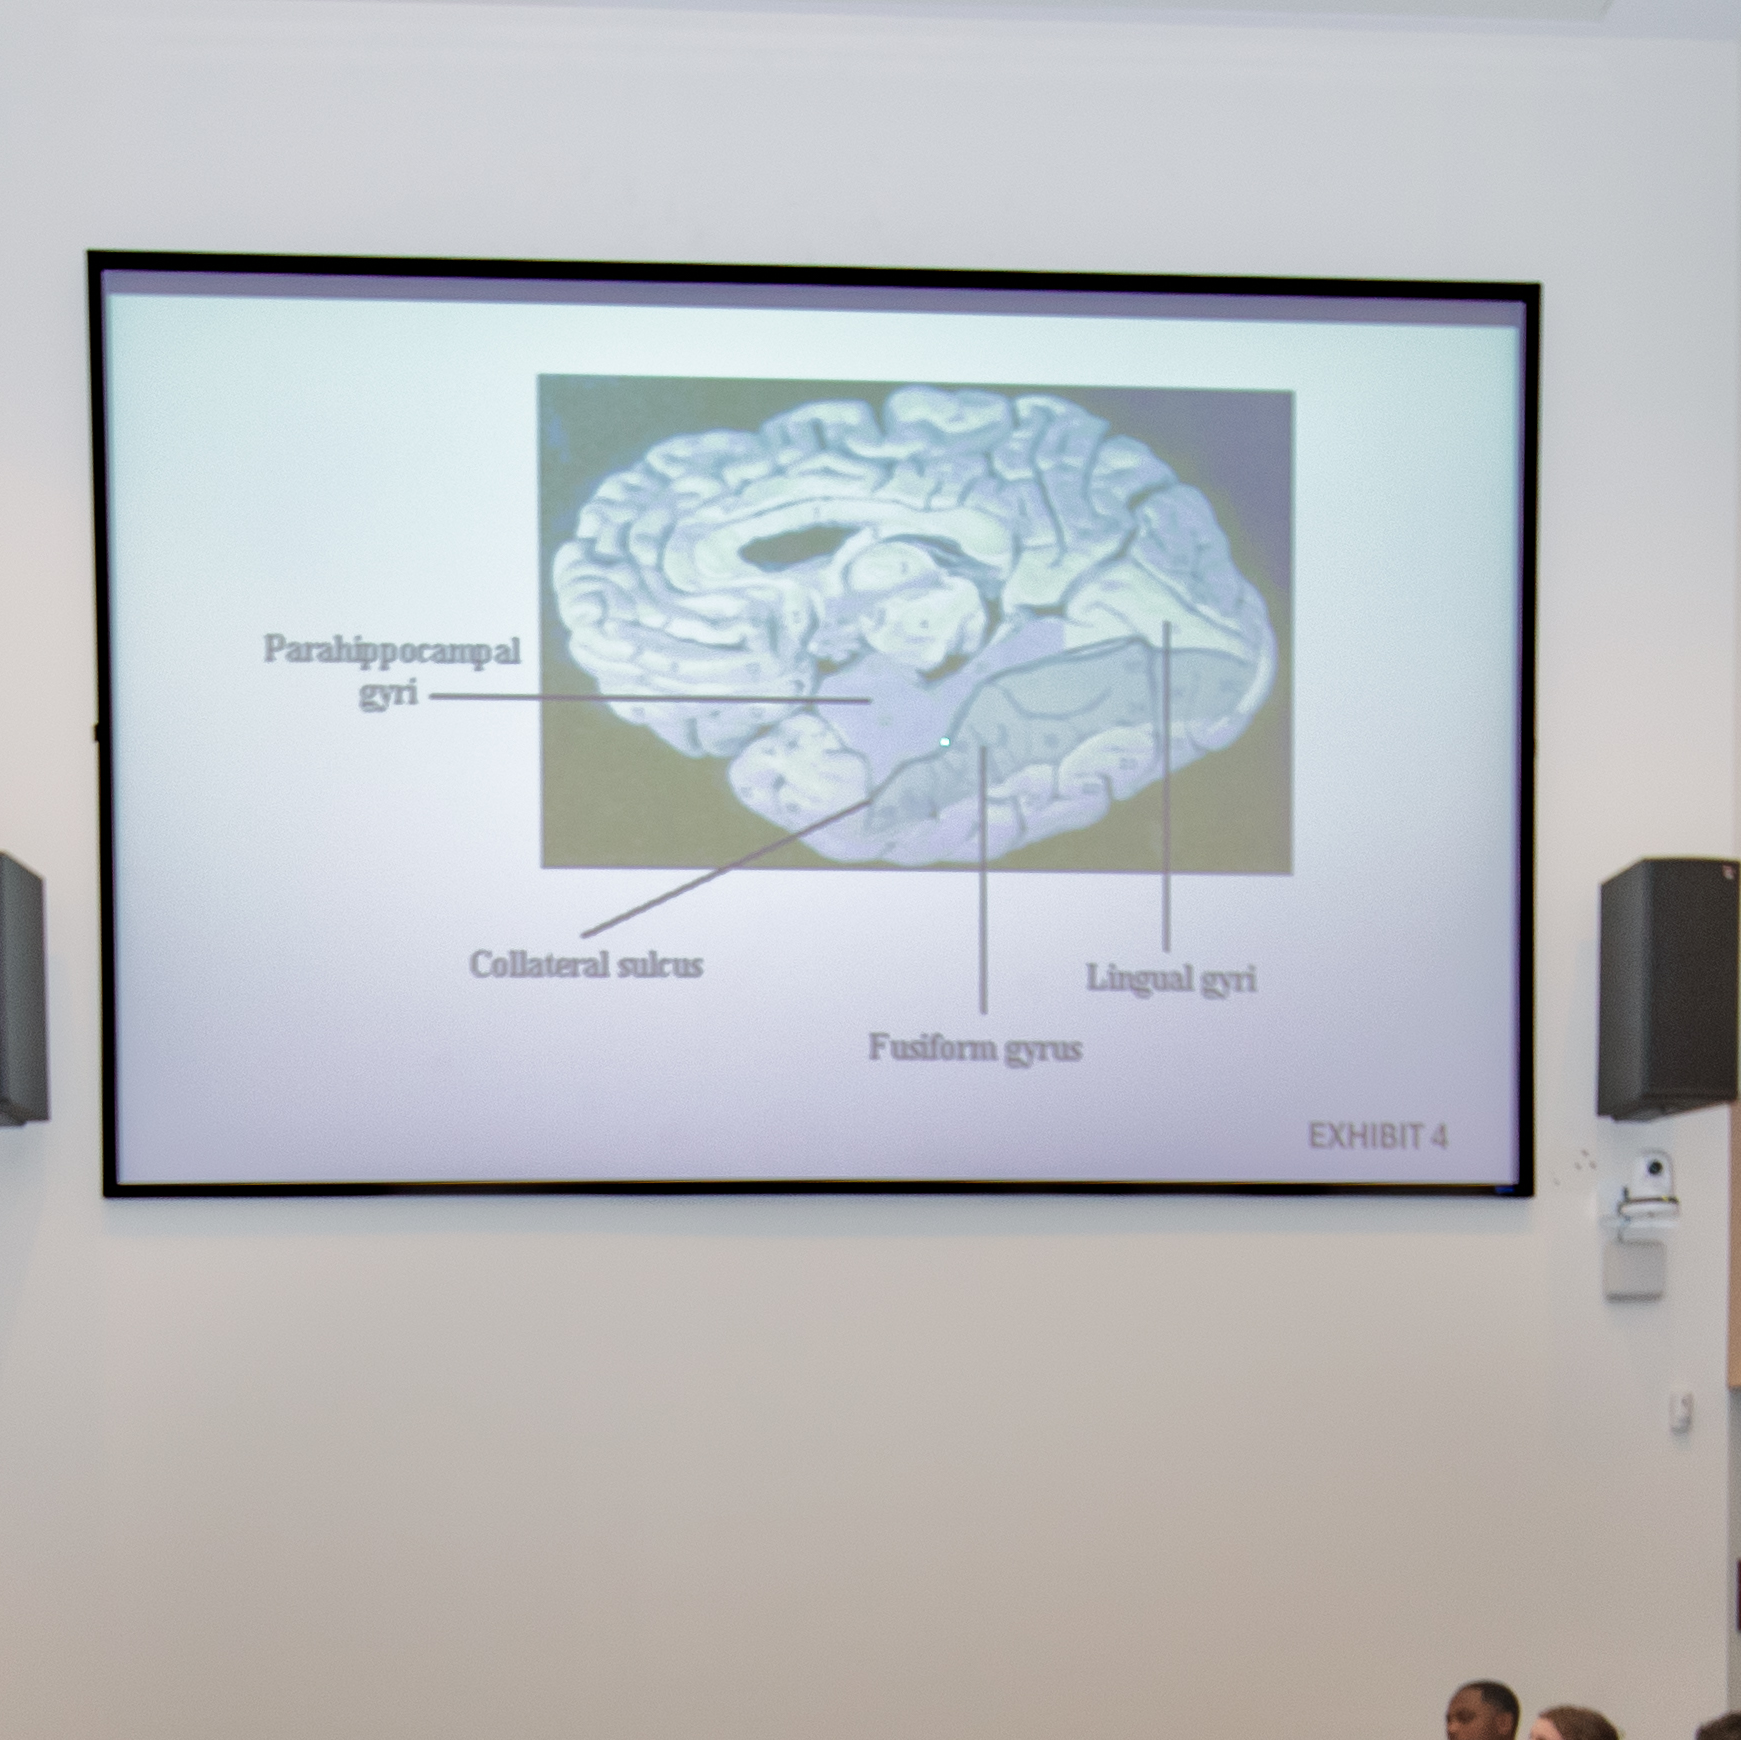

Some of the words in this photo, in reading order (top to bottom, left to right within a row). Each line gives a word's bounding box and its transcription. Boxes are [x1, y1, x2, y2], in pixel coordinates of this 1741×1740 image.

[263, 632, 522, 671] Parahippocampal
[359, 677, 420, 712] gyri
[468, 949, 611, 979] Collateral
[617, 950, 705, 979] sulcus
[1086, 961, 1196, 1000] Lingual
[1200, 963, 1259, 1000] gyri
[868, 1031, 1000, 1063] Fusiform
[1003, 1038, 1085, 1070] gyrus
[1309, 1119, 1426, 1150] EXHIBIT
[1430, 1122, 1448, 1150] 4
